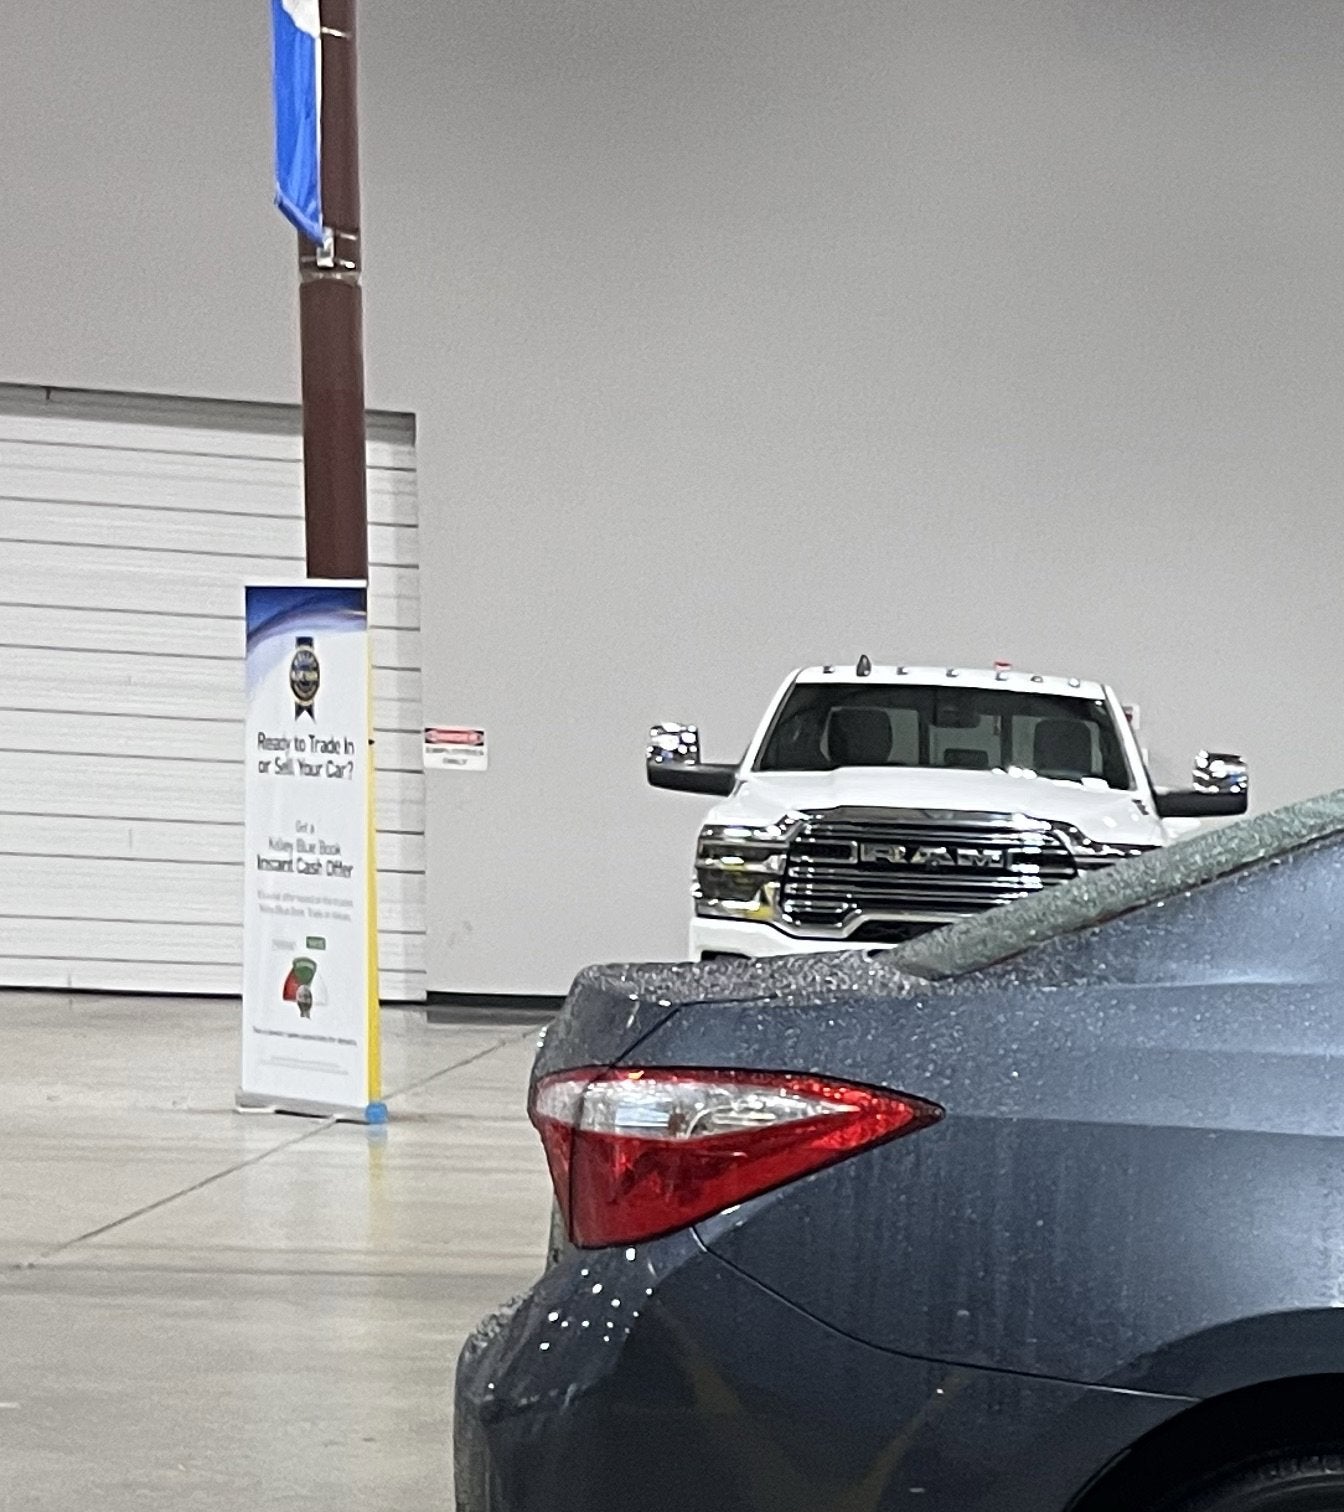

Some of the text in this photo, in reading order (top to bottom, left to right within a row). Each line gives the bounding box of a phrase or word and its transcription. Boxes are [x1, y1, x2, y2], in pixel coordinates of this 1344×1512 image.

[257, 731, 355, 757] Ready to Trade In
[258, 756, 354, 781] or Sell Your Car?
[257, 853, 354, 879] Instant Cash Offer
[859, 842, 1003, 868] RAM
